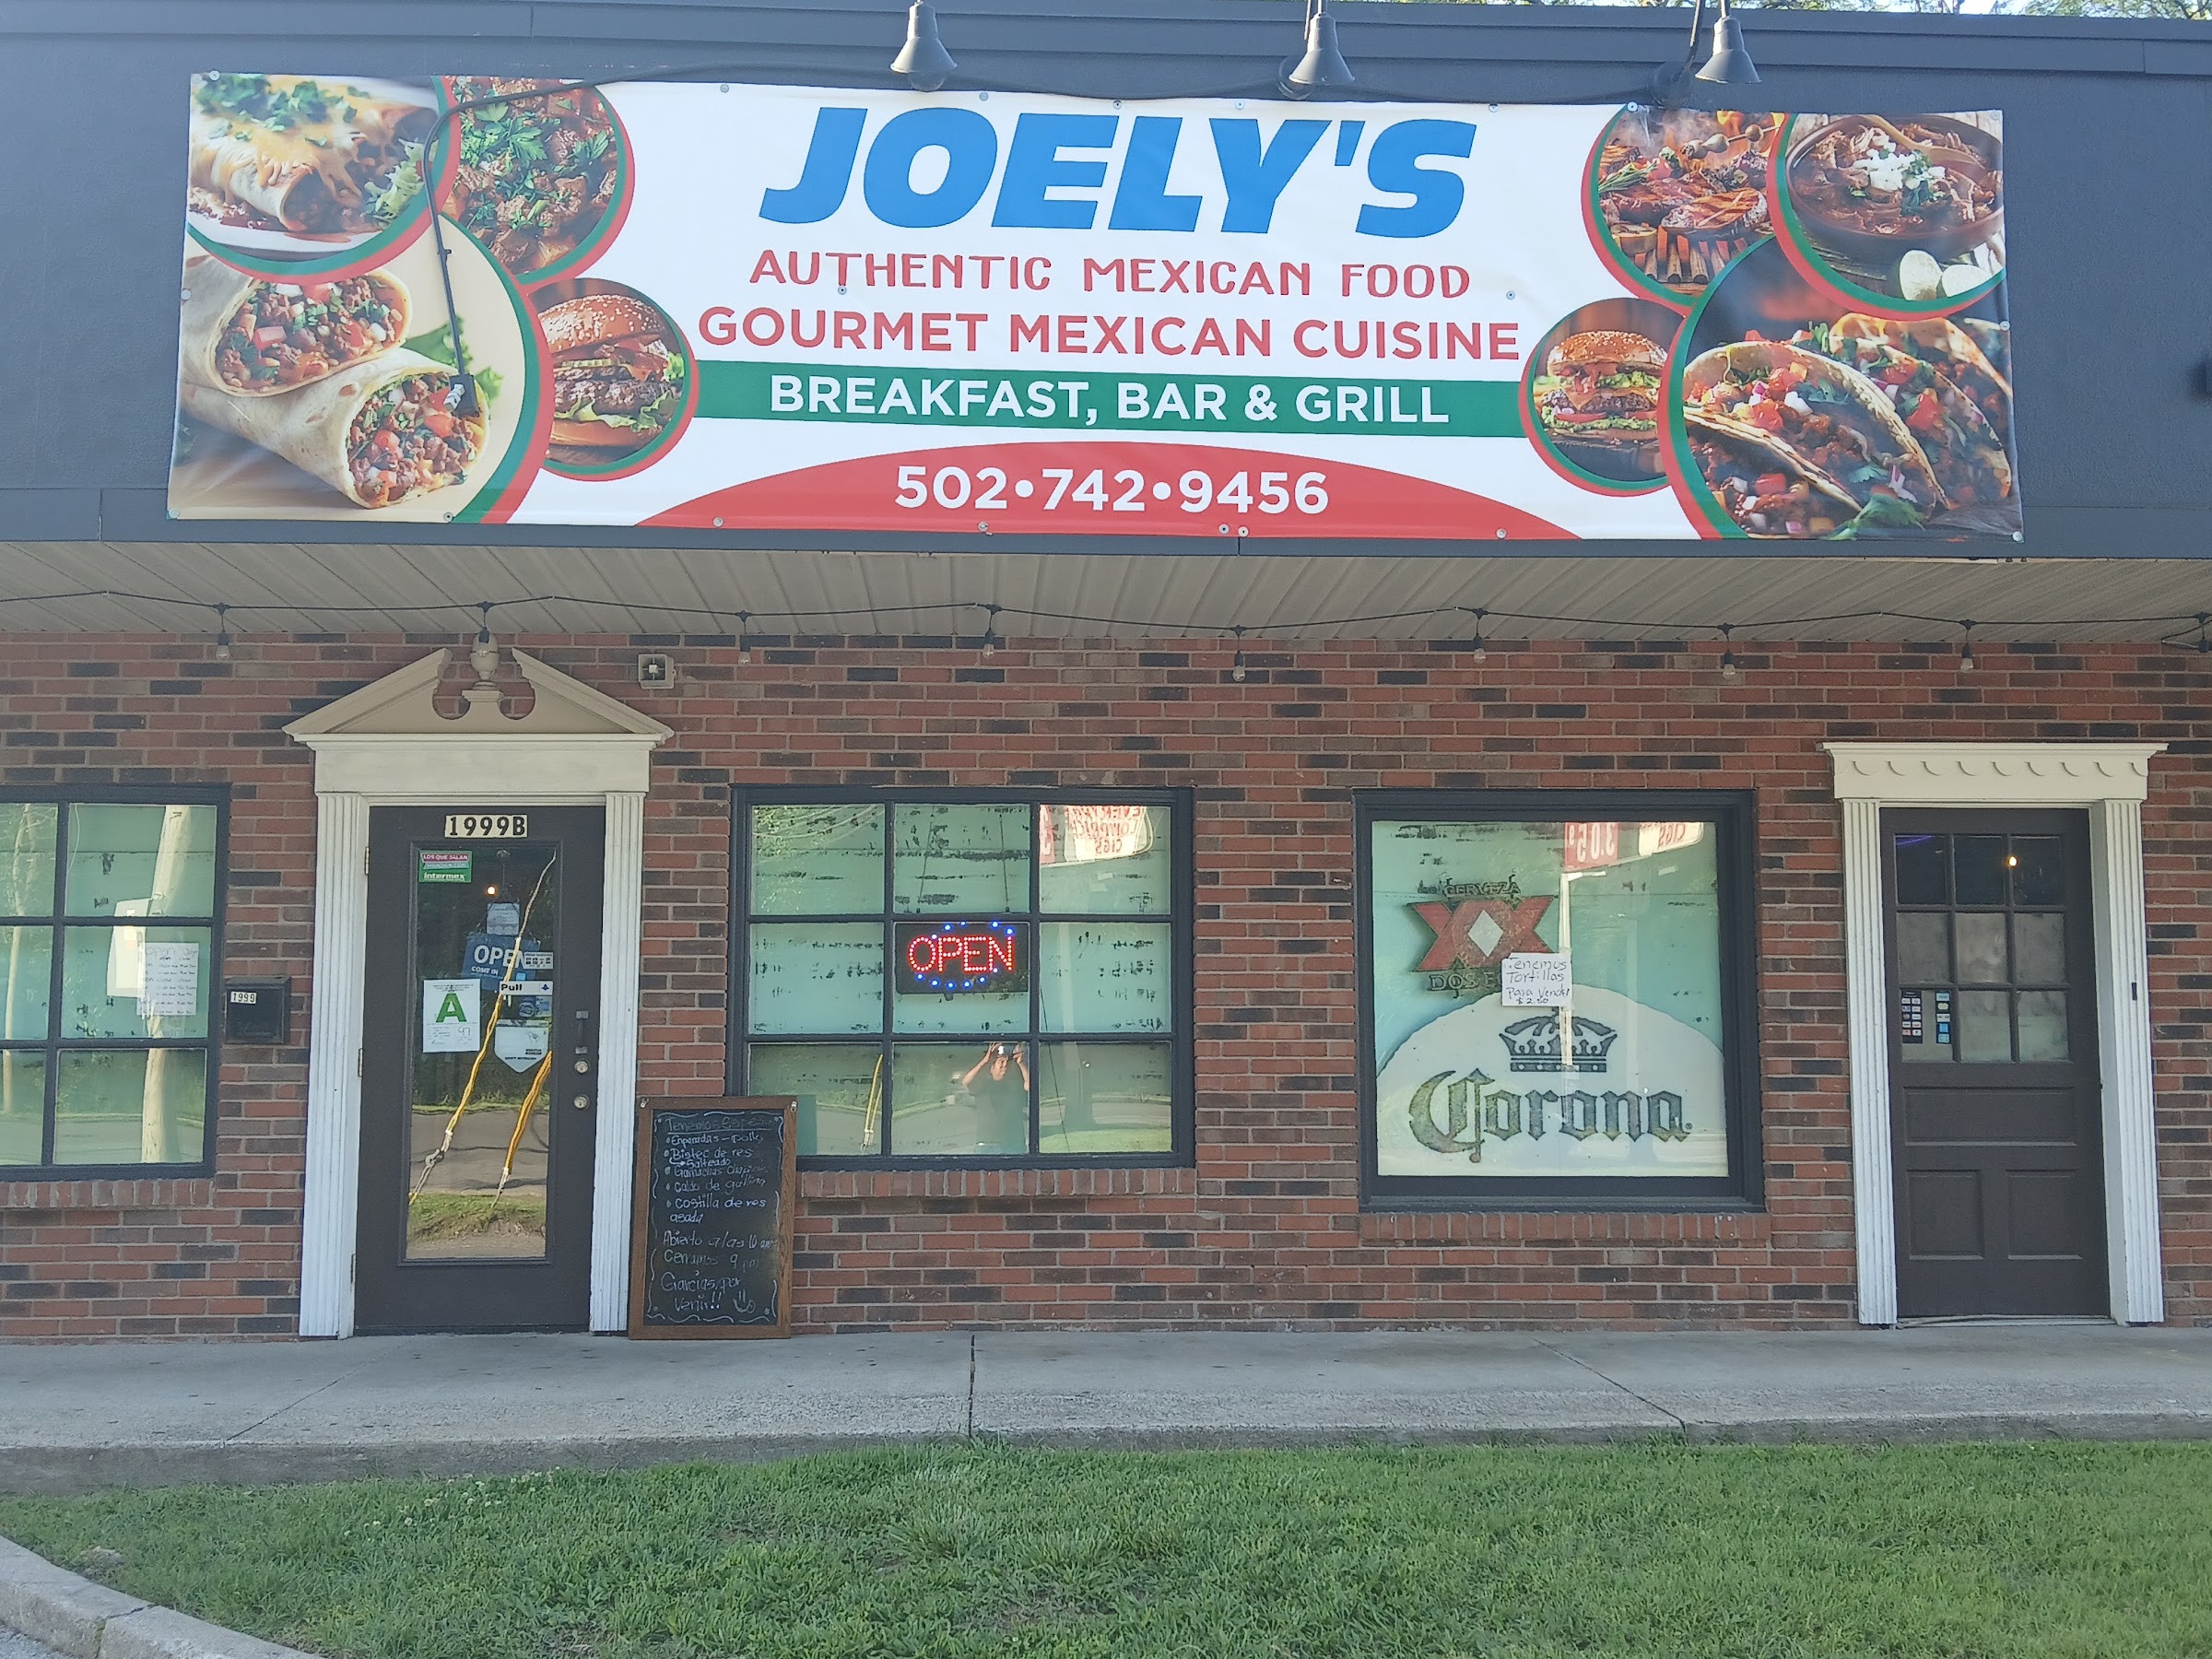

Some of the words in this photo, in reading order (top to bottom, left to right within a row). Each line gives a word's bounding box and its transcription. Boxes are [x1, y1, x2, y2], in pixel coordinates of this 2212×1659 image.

[759, 106, 1478, 240] JOELY'S
[749, 249, 1052, 291] AUTHENTIC
[1083, 258, 1312, 297] MEXICAN
[1341, 264, 1471, 300] FOOD
[699, 307, 990, 353] GOURMET
[1010, 314, 1272, 358] MEXICAN
[1293, 319, 1521, 361] CUISINE
[771, 374, 1098, 427] BREAKFAST,
[1117, 382, 1228, 421] BAR
[1244, 383, 1278, 422] &
[1295, 384, 1450, 424] GRILL
[449, 816, 525, 836] 1999B
[1444, 881, 1521, 898] CERVEZA
[908, 935, 1014, 973] OPEN
[1430, 973, 1477, 990] DOS
[1506, 970, 1565, 983] Tortillas
[233, 993, 255, 1003] 1999
[436, 993, 467, 1023] A
[1408, 1067, 1690, 1163] Corona
[714, 1147, 727, 1159] de
[732, 1147, 754, 1158] res
[706, 1178, 720, 1191] de
[724, 1196, 743, 1208] de
